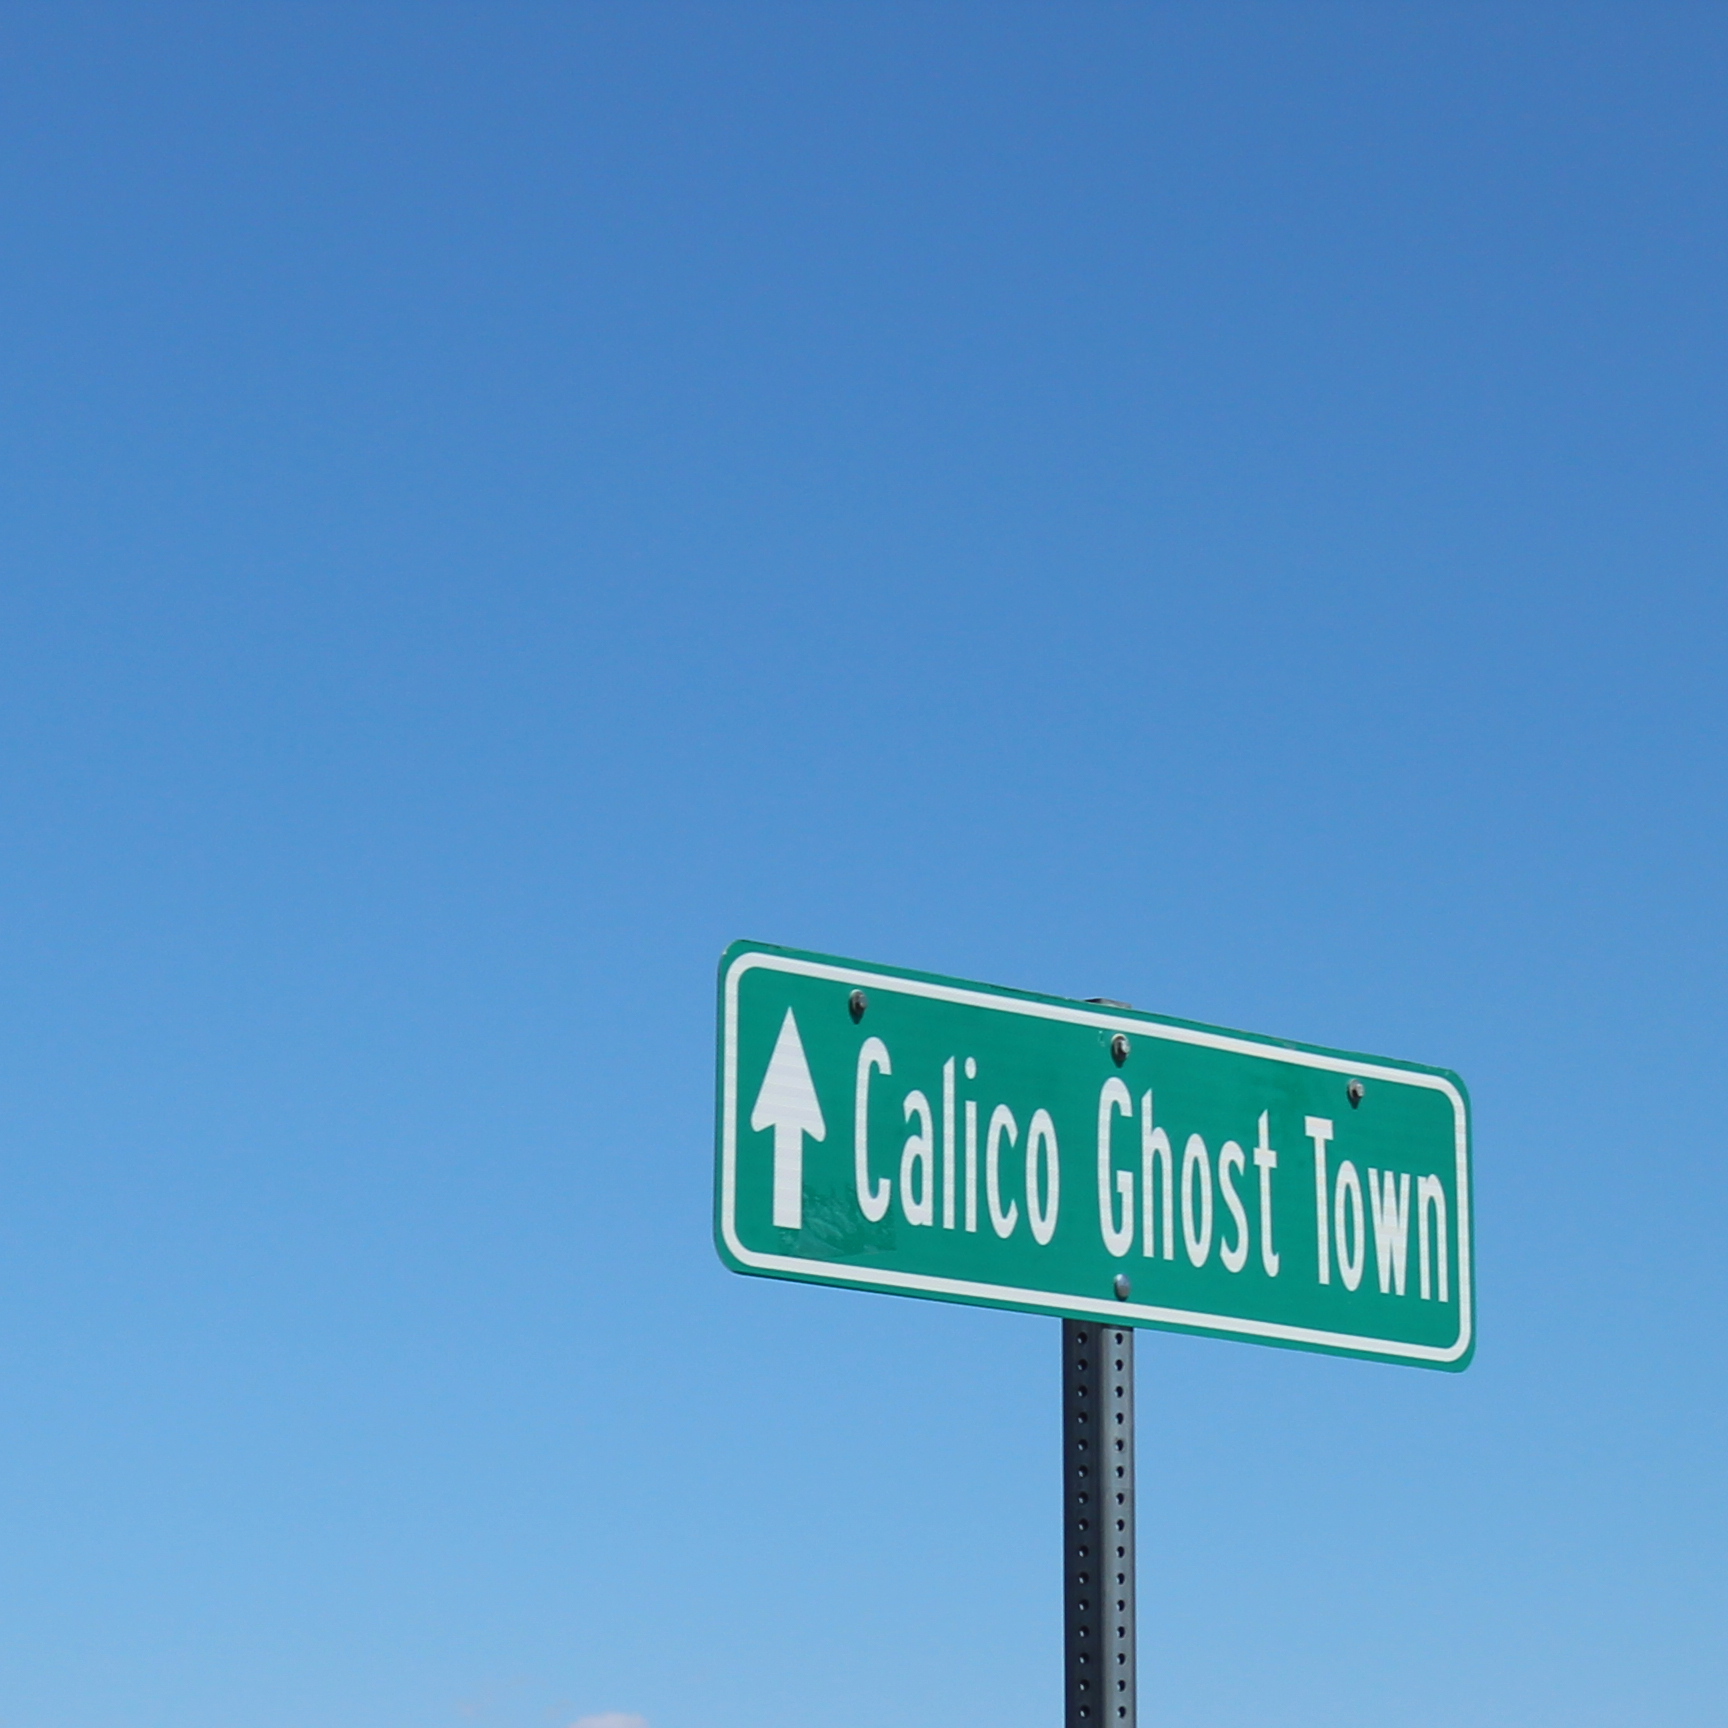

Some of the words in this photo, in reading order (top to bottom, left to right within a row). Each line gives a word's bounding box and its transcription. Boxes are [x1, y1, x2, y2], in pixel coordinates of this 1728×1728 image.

[854, 1036, 1060, 1246] Calico
[1097, 1076, 1280, 1278] Ghost
[1304, 1115, 1450, 1303] Town
